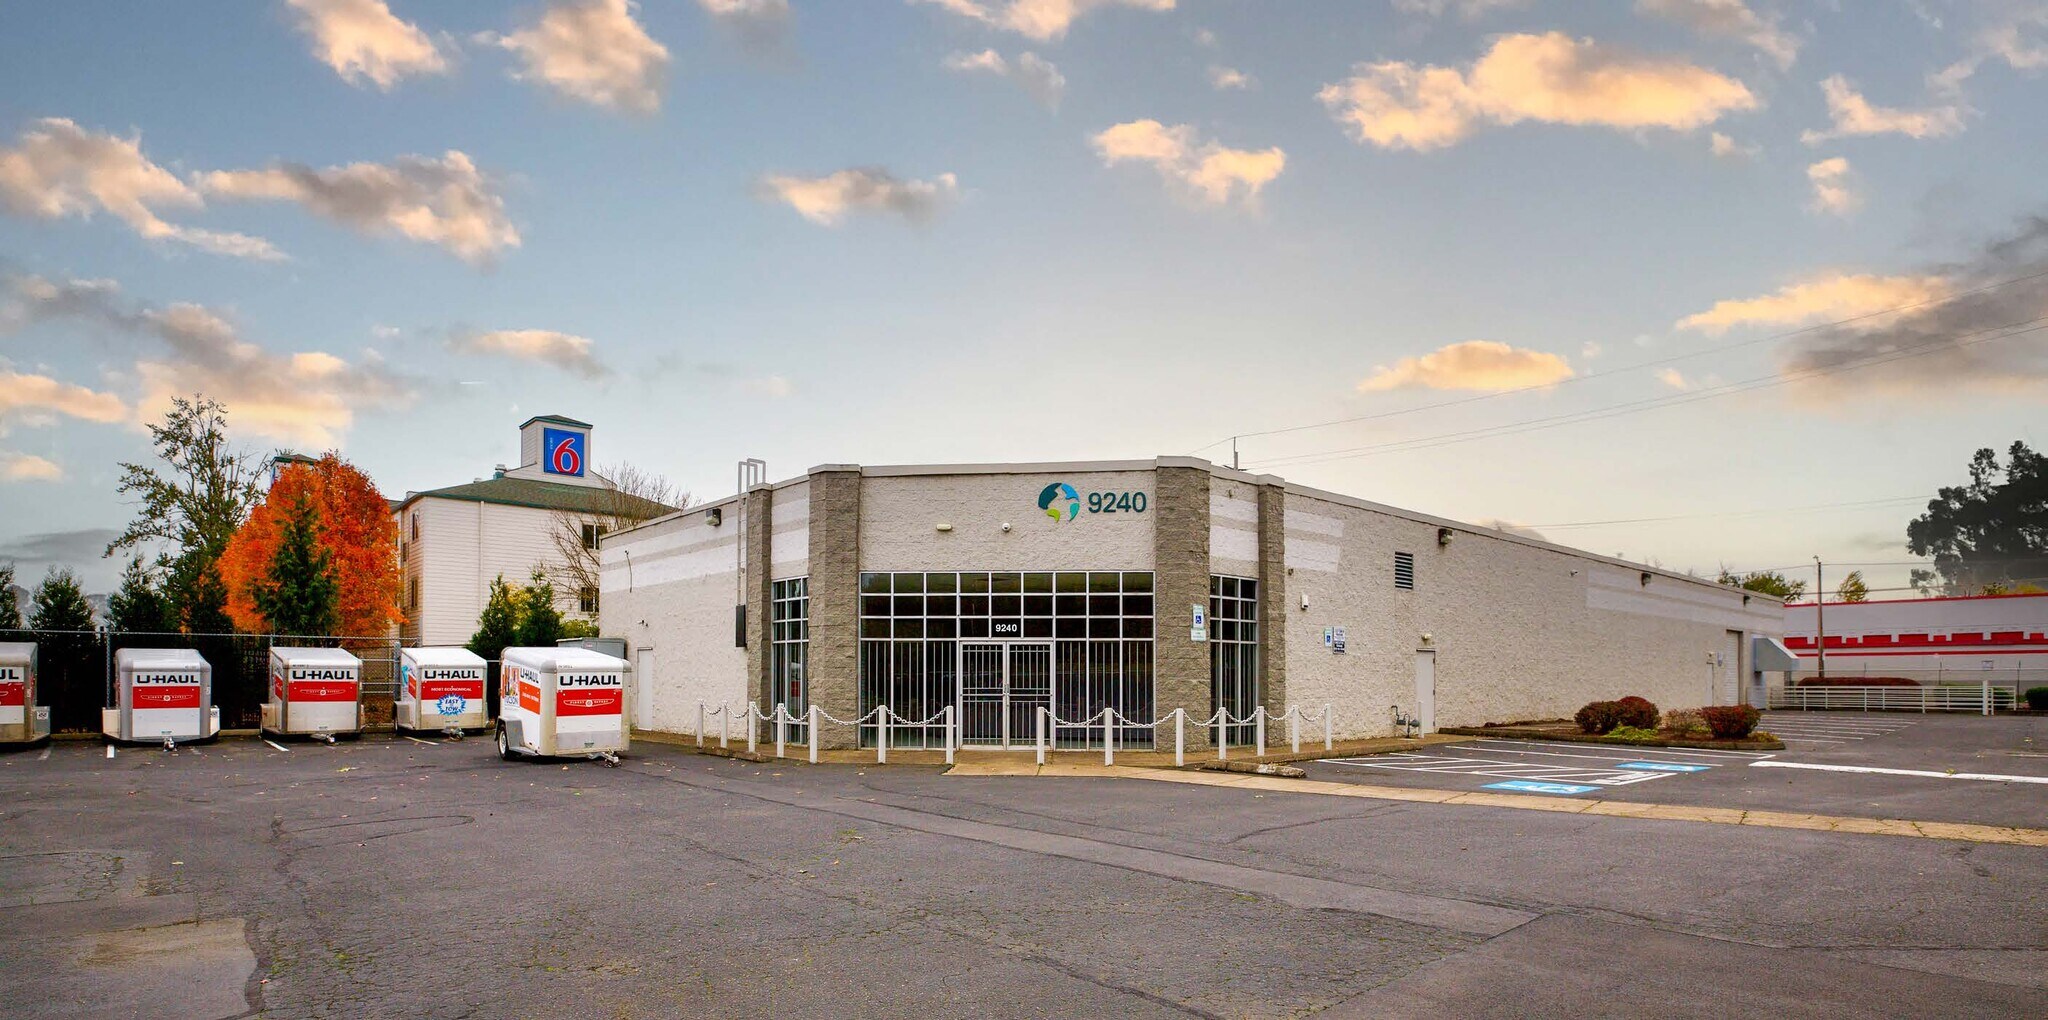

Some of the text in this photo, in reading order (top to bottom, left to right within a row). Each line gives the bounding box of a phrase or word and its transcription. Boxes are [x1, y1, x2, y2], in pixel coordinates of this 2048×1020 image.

[553, 437, 580, 474] 6
[1087, 491, 1147, 514] 9240
[995, 623, 1018, 632] 9240
[136, 674, 199, 684] U-HAUL
[292, 670, 355, 680] U-HAUL
[424, 670, 480, 679] U-HAUL
[559, 675, 621, 686] U-HAUL
